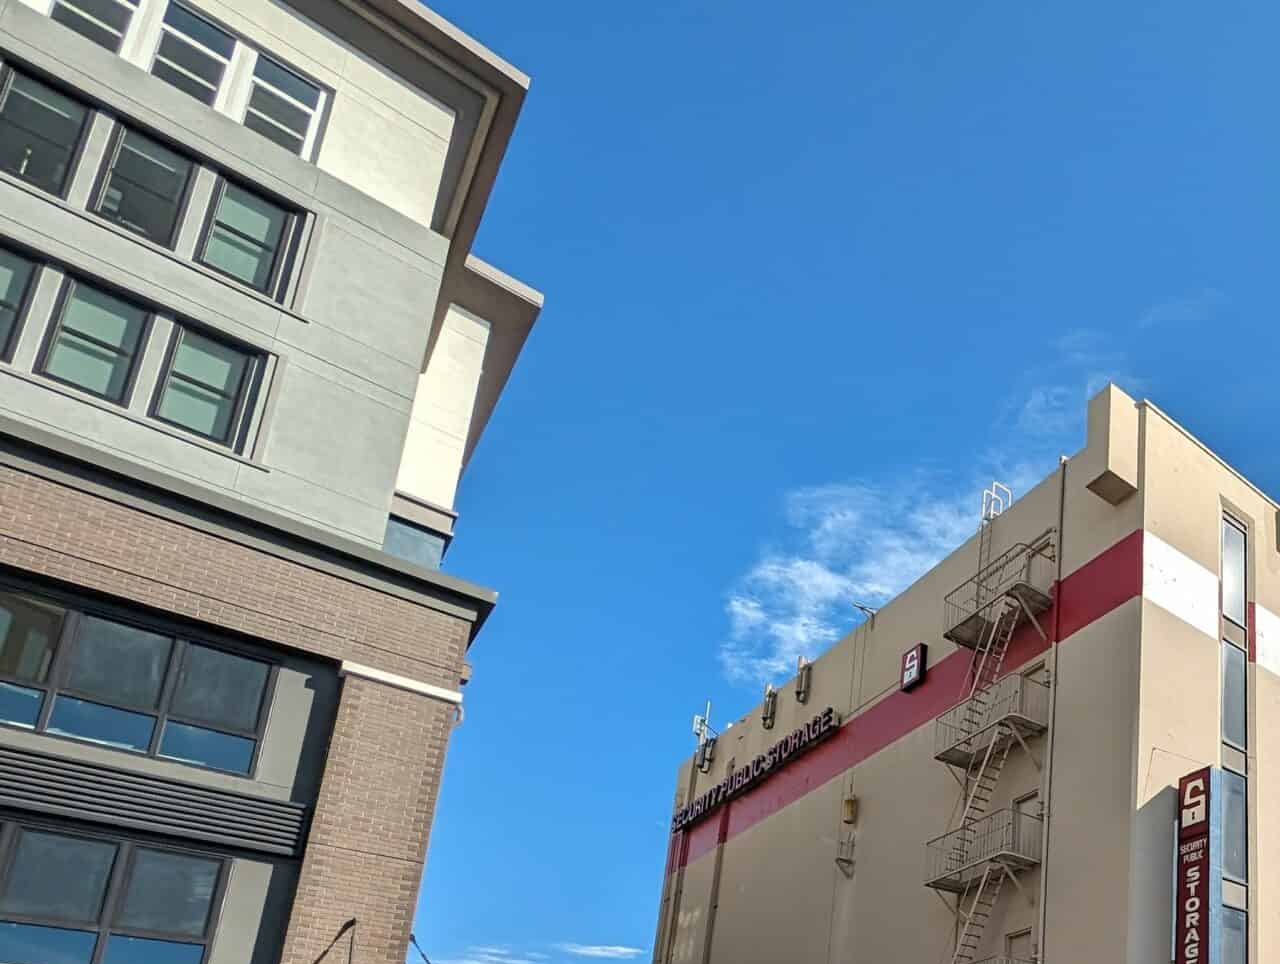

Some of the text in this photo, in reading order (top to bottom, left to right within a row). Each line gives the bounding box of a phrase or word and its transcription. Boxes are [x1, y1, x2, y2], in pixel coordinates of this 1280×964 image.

[671, 707, 836, 832] SECURITY PUBLIC STORAGE
[1180, 838, 1208, 856] SECURITY
[1183, 850, 1204, 865] PUBLIC
